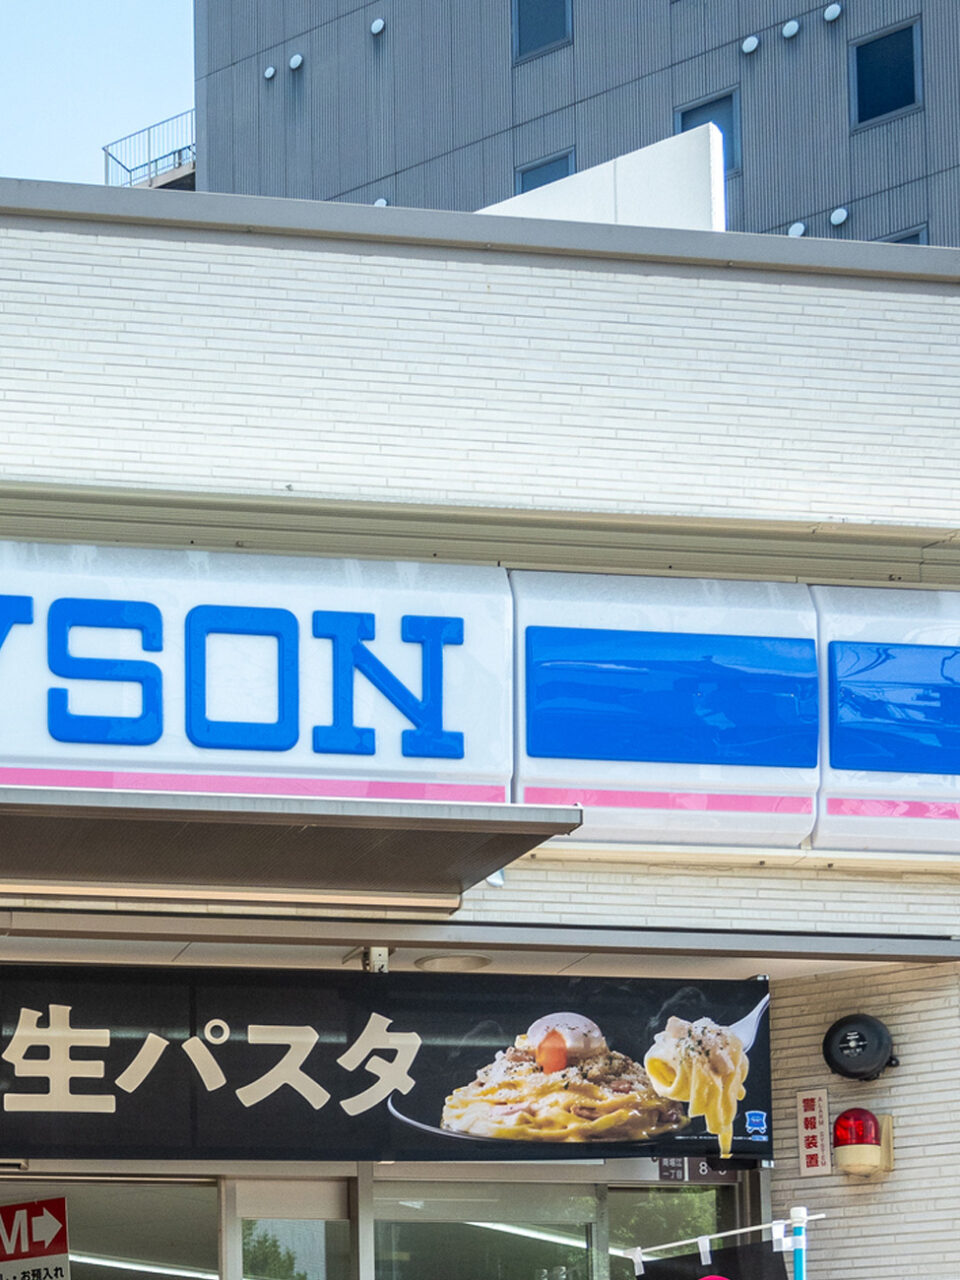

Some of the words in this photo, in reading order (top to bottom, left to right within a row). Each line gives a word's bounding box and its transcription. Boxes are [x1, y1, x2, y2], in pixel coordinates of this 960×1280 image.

[1, 1004, 423, 1117] 生パスタ
[698, 1161, 709, 1176] 8
[802, 1097, 820, 1169] 警報装置
